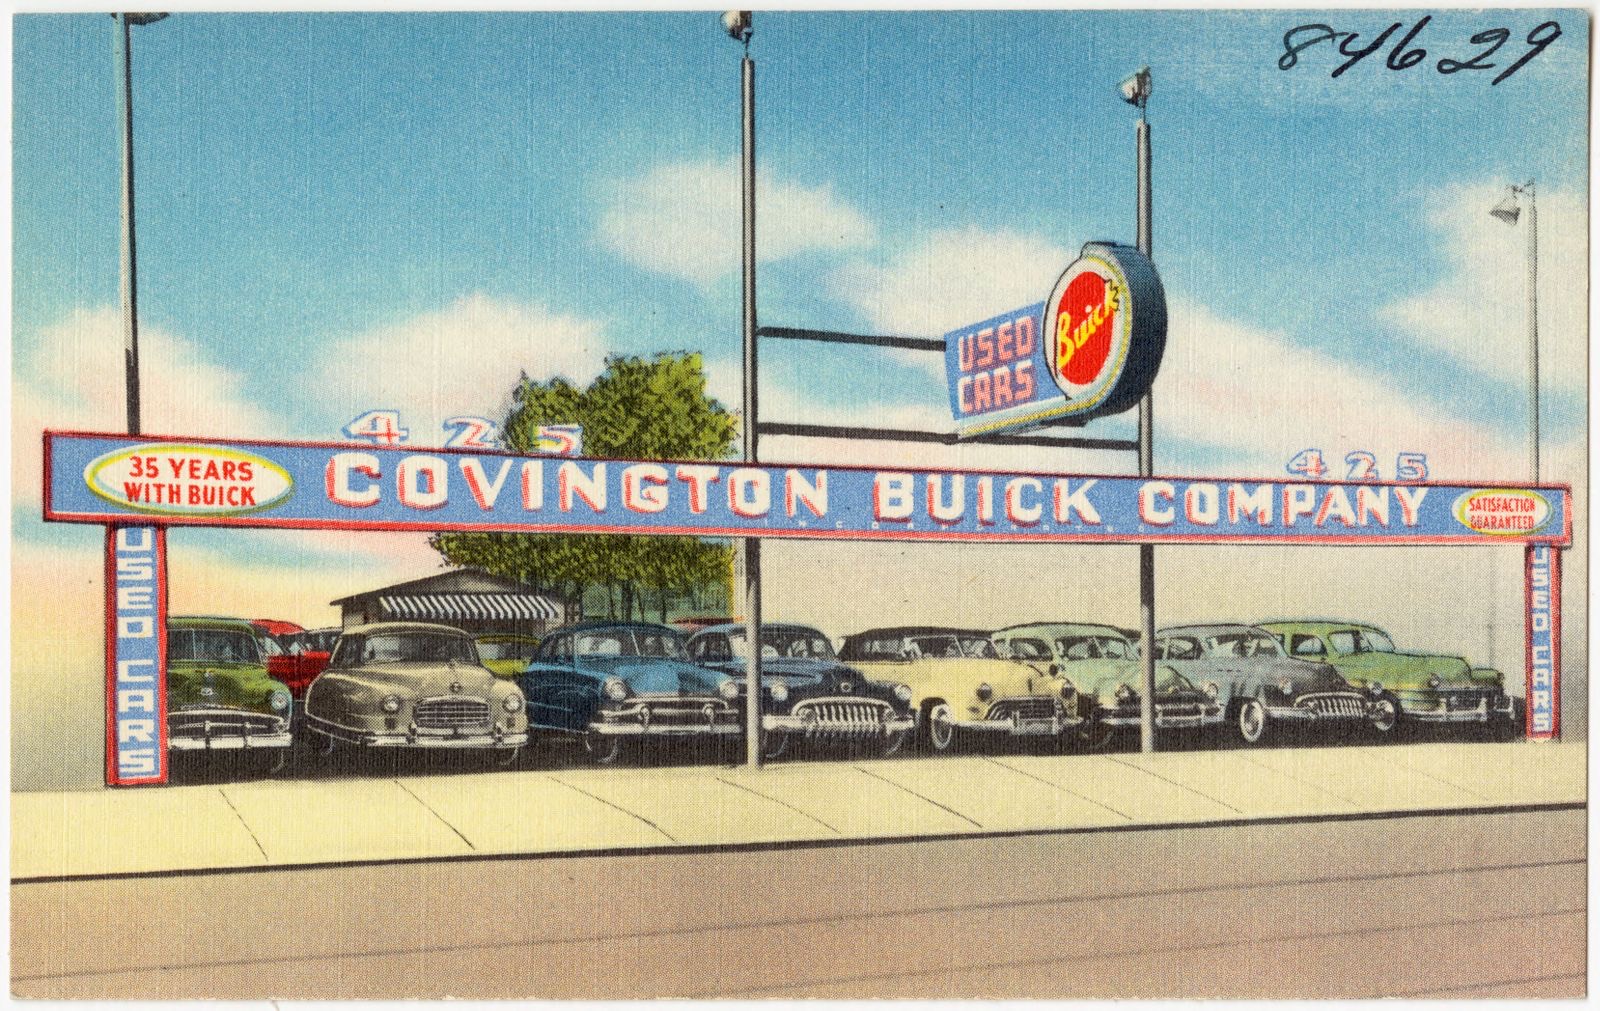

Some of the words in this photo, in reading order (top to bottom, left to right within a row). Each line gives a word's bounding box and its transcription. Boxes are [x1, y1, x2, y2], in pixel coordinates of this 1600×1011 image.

[1278, 15, 1562, 86] 84629
[958, 315, 1037, 373] USED
[1057, 278, 1121, 369] Buick
[957, 358, 1038, 415] CARS
[124, 482, 181, 504] WITH
[188, 485, 256, 507] BUICK
[129, 456, 159, 479] 35
[168, 458, 253, 481] YEARS
[325, 452, 828, 518] COVINGTON
[873, 471, 1101, 525] BUICK
[1138, 481, 1430, 528] COMPANY
[1469, 497, 1536, 513] SATISFACTION
[1470, 514, 1535, 530] GUARANTEED
[117, 527, 153, 638] USED
[1532, 546, 1550, 632] USED
[118, 660, 156, 779] CARS
[1533, 646, 1552, 732] CARS
